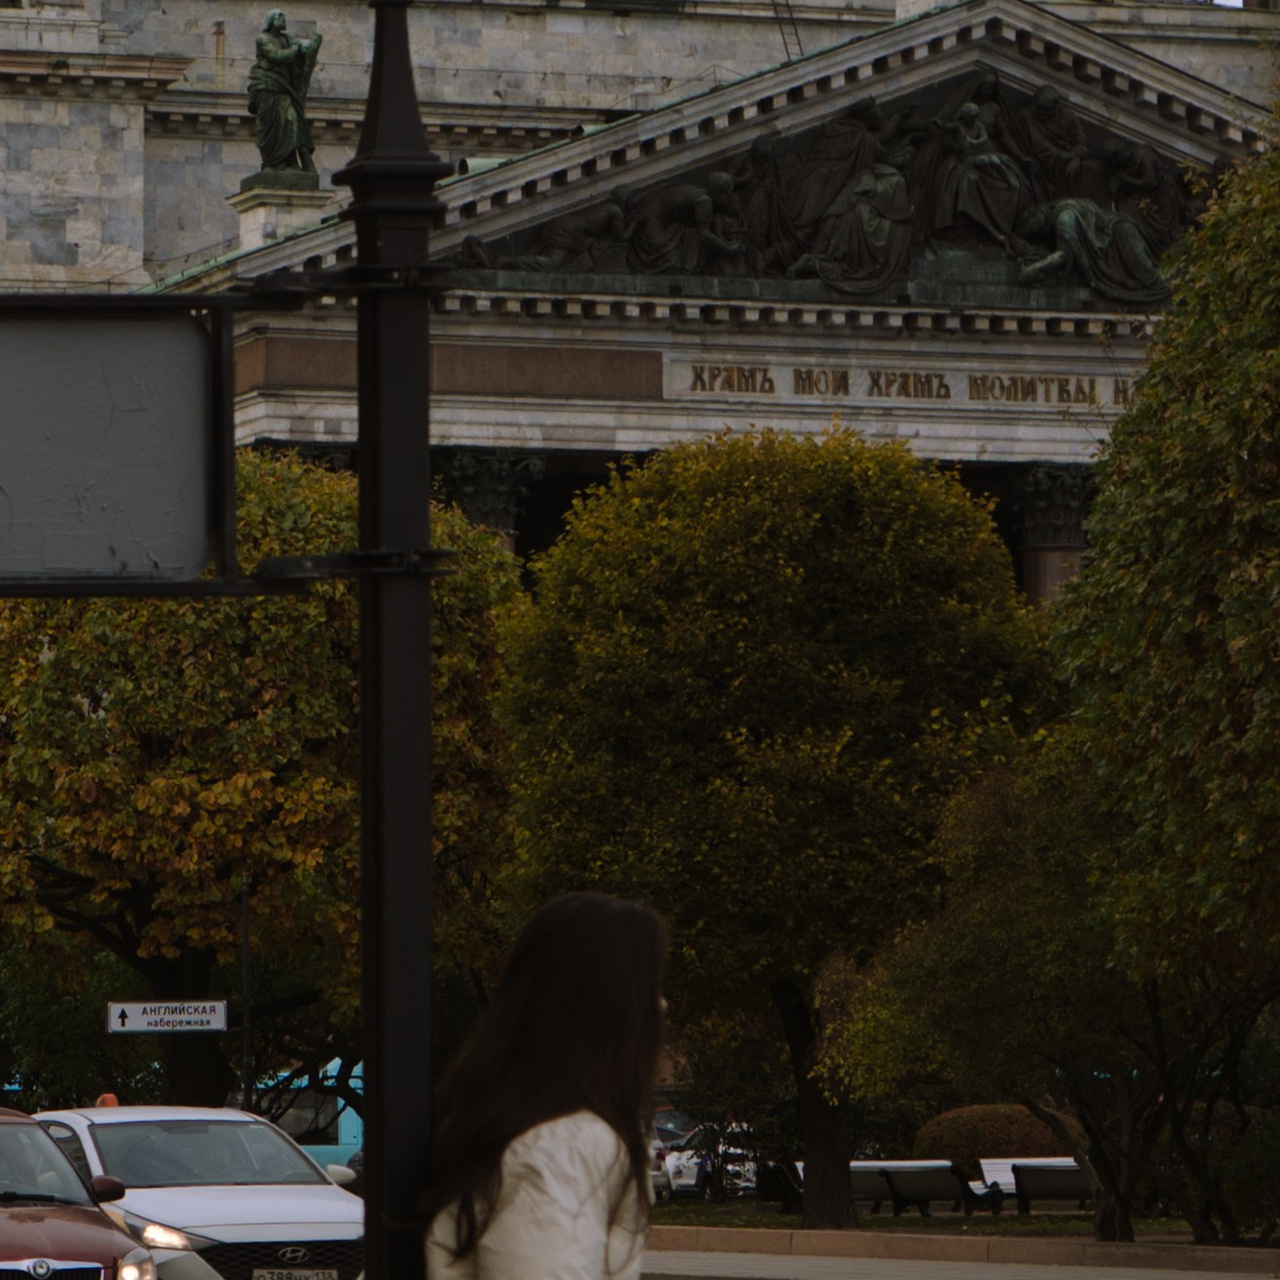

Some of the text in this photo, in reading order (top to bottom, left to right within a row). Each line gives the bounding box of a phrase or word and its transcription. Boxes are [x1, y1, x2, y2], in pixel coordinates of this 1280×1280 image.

[690, 365, 775, 394] ХРАМЪ
[867, 370, 951, 399] ХРАМЪ
[968, 374, 1096, 404] МОЛИТВЫ
[141, 1003, 217, 1016] АНГЛИЙСКАЯ
[147, 1018, 211, 1028] набережная
